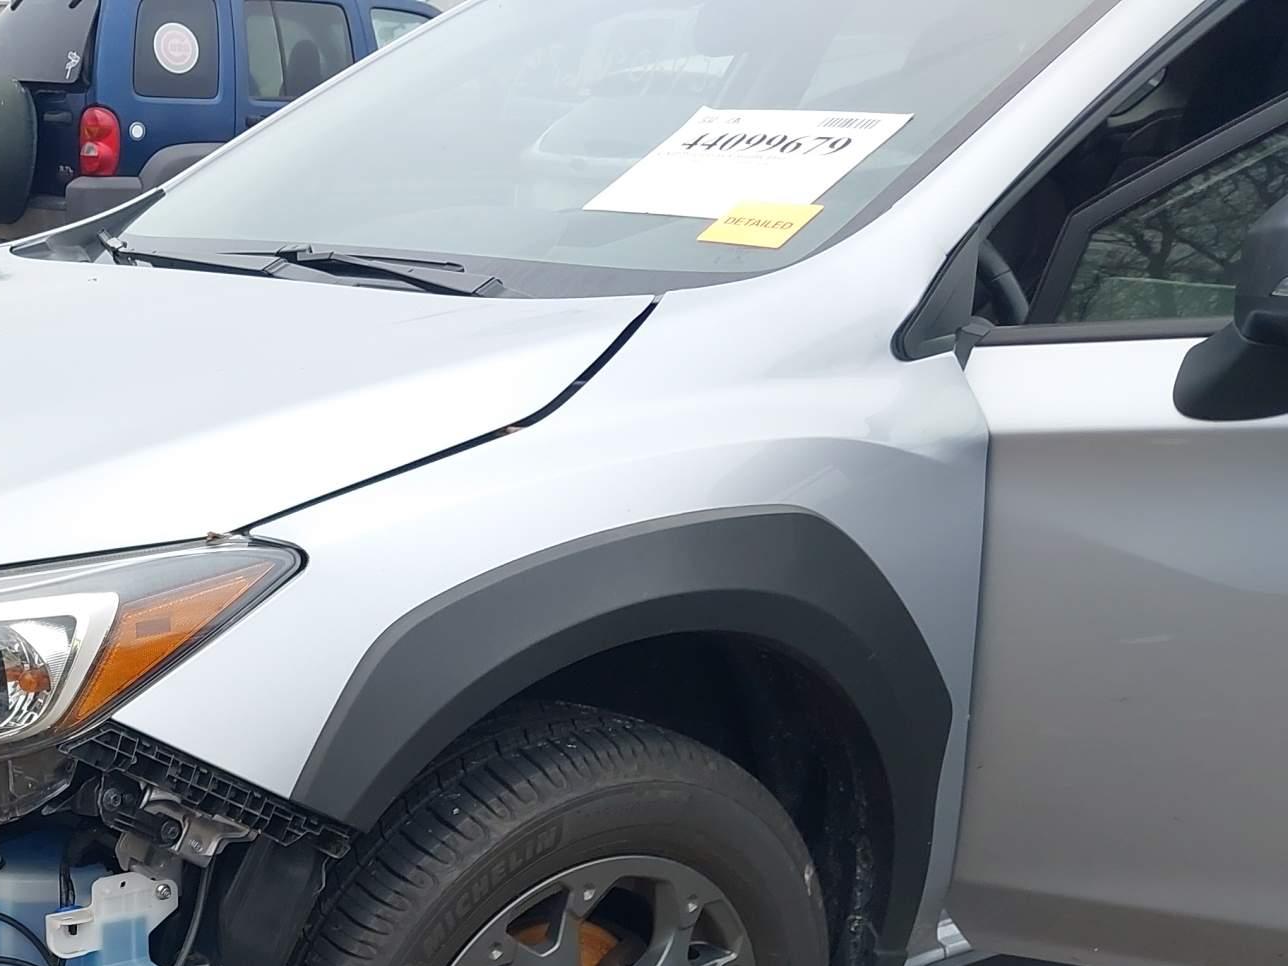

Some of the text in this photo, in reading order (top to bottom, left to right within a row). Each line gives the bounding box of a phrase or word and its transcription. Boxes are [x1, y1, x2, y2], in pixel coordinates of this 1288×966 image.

[681, 132, 853, 156] 44099679
[723, 214, 795, 232] DETAILED
[422, 827, 559, 957] MICHELIN
